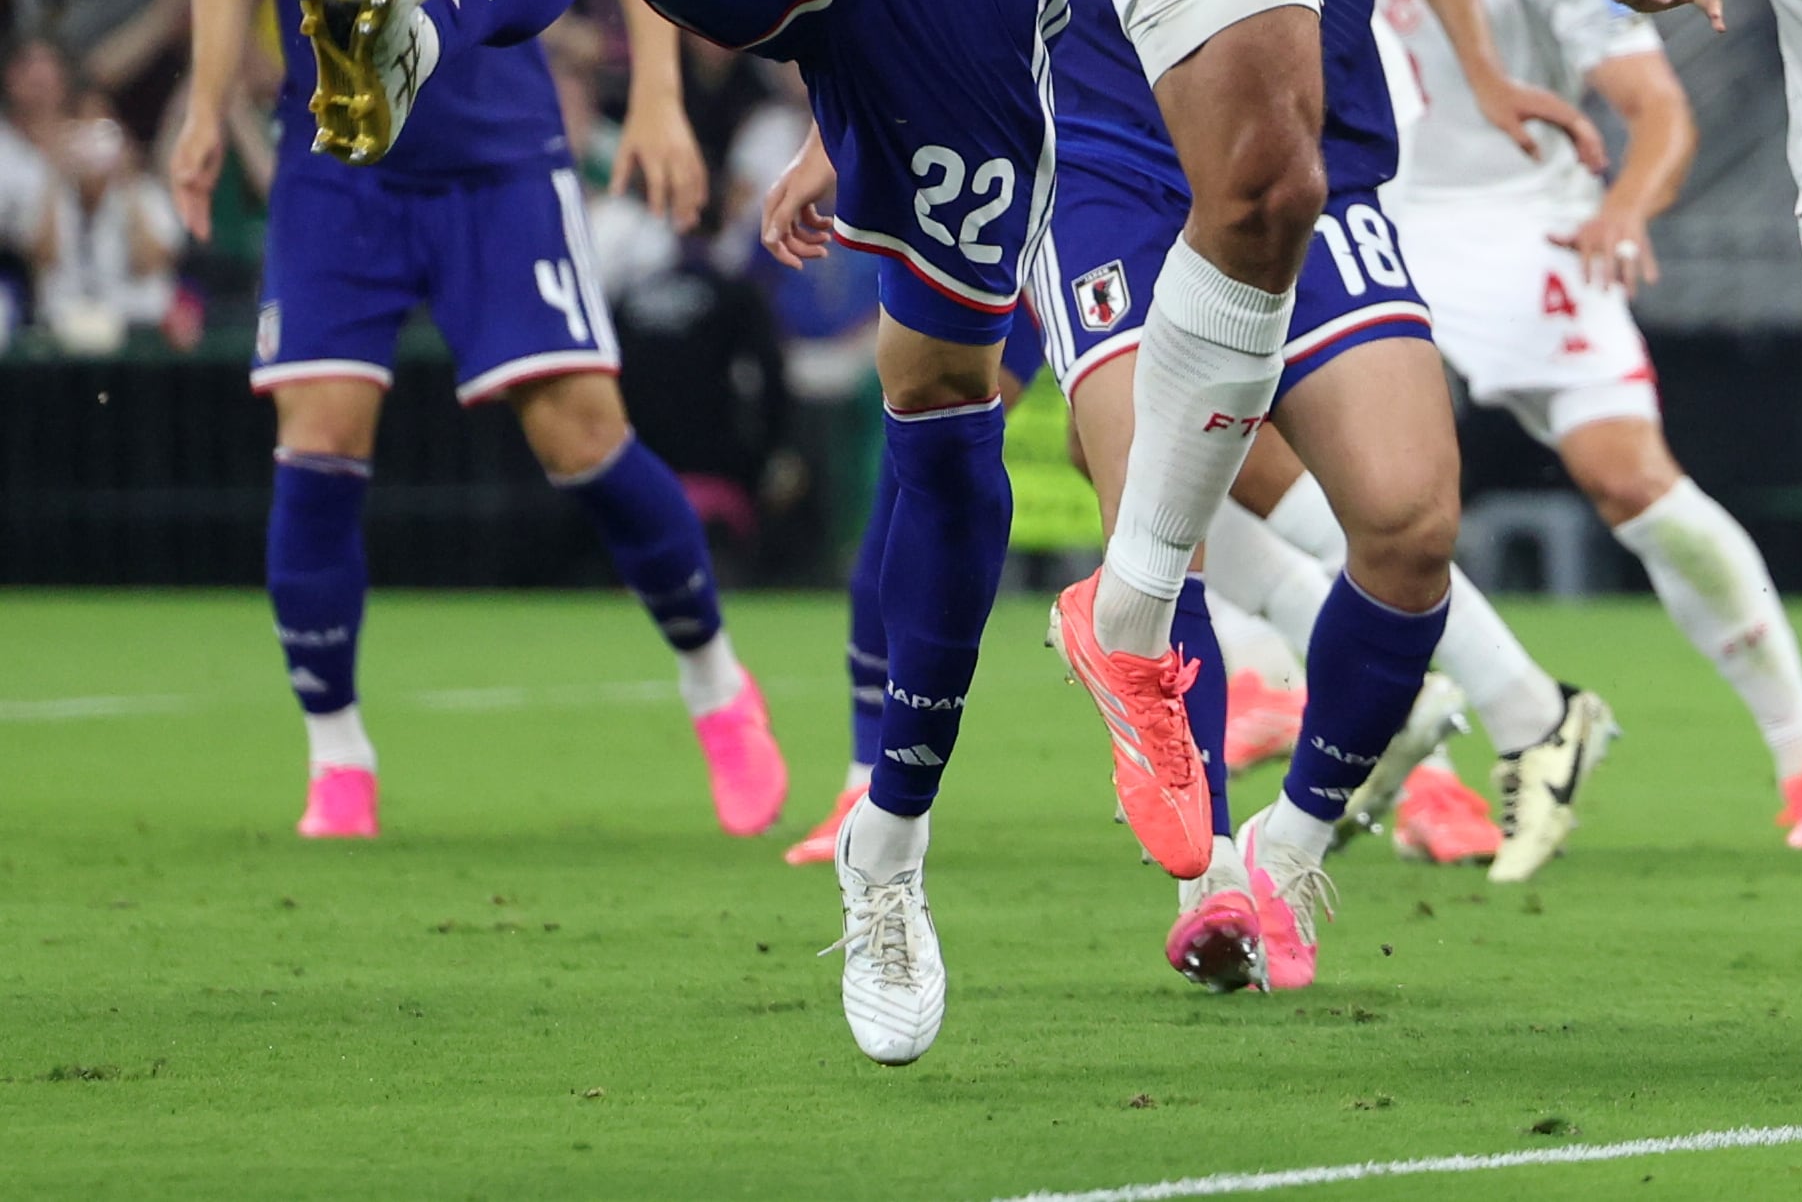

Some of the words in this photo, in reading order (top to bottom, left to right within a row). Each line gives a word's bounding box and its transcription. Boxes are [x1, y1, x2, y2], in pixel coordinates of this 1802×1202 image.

[911, 144, 1015, 264] 22
[1313, 203, 1409, 297] 18
[1543, 272, 1578, 318] 4
[533, 257, 589, 343] 4
